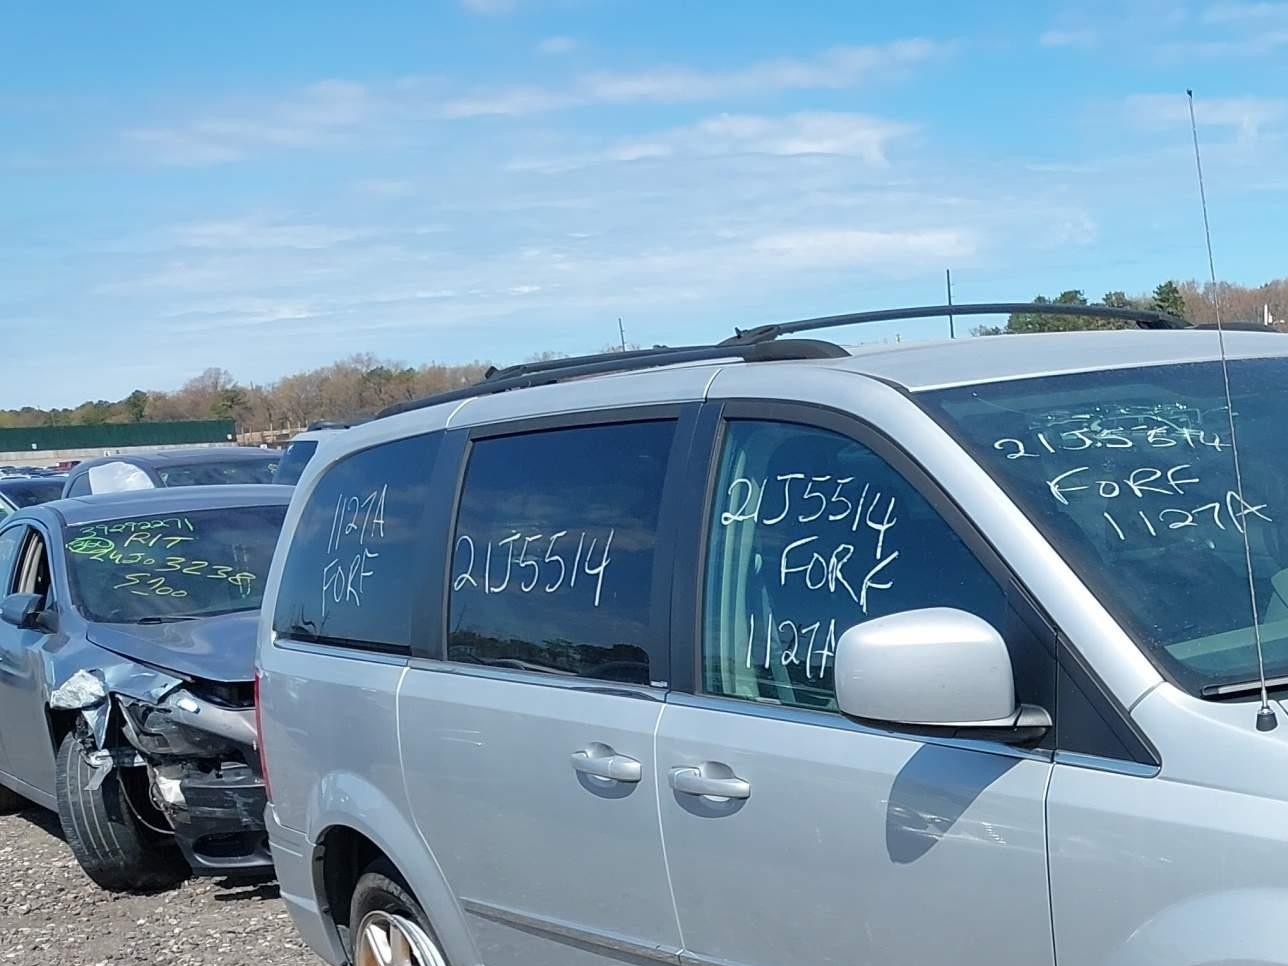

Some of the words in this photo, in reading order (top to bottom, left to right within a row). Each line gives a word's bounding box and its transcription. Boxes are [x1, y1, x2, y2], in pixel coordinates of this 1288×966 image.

[328, 484, 388, 554] 1127A
[721, 474, 898, 560] 21J5514
[1103, 490, 1273, 541] 1127A
[453, 528, 615, 607] 21J5514
